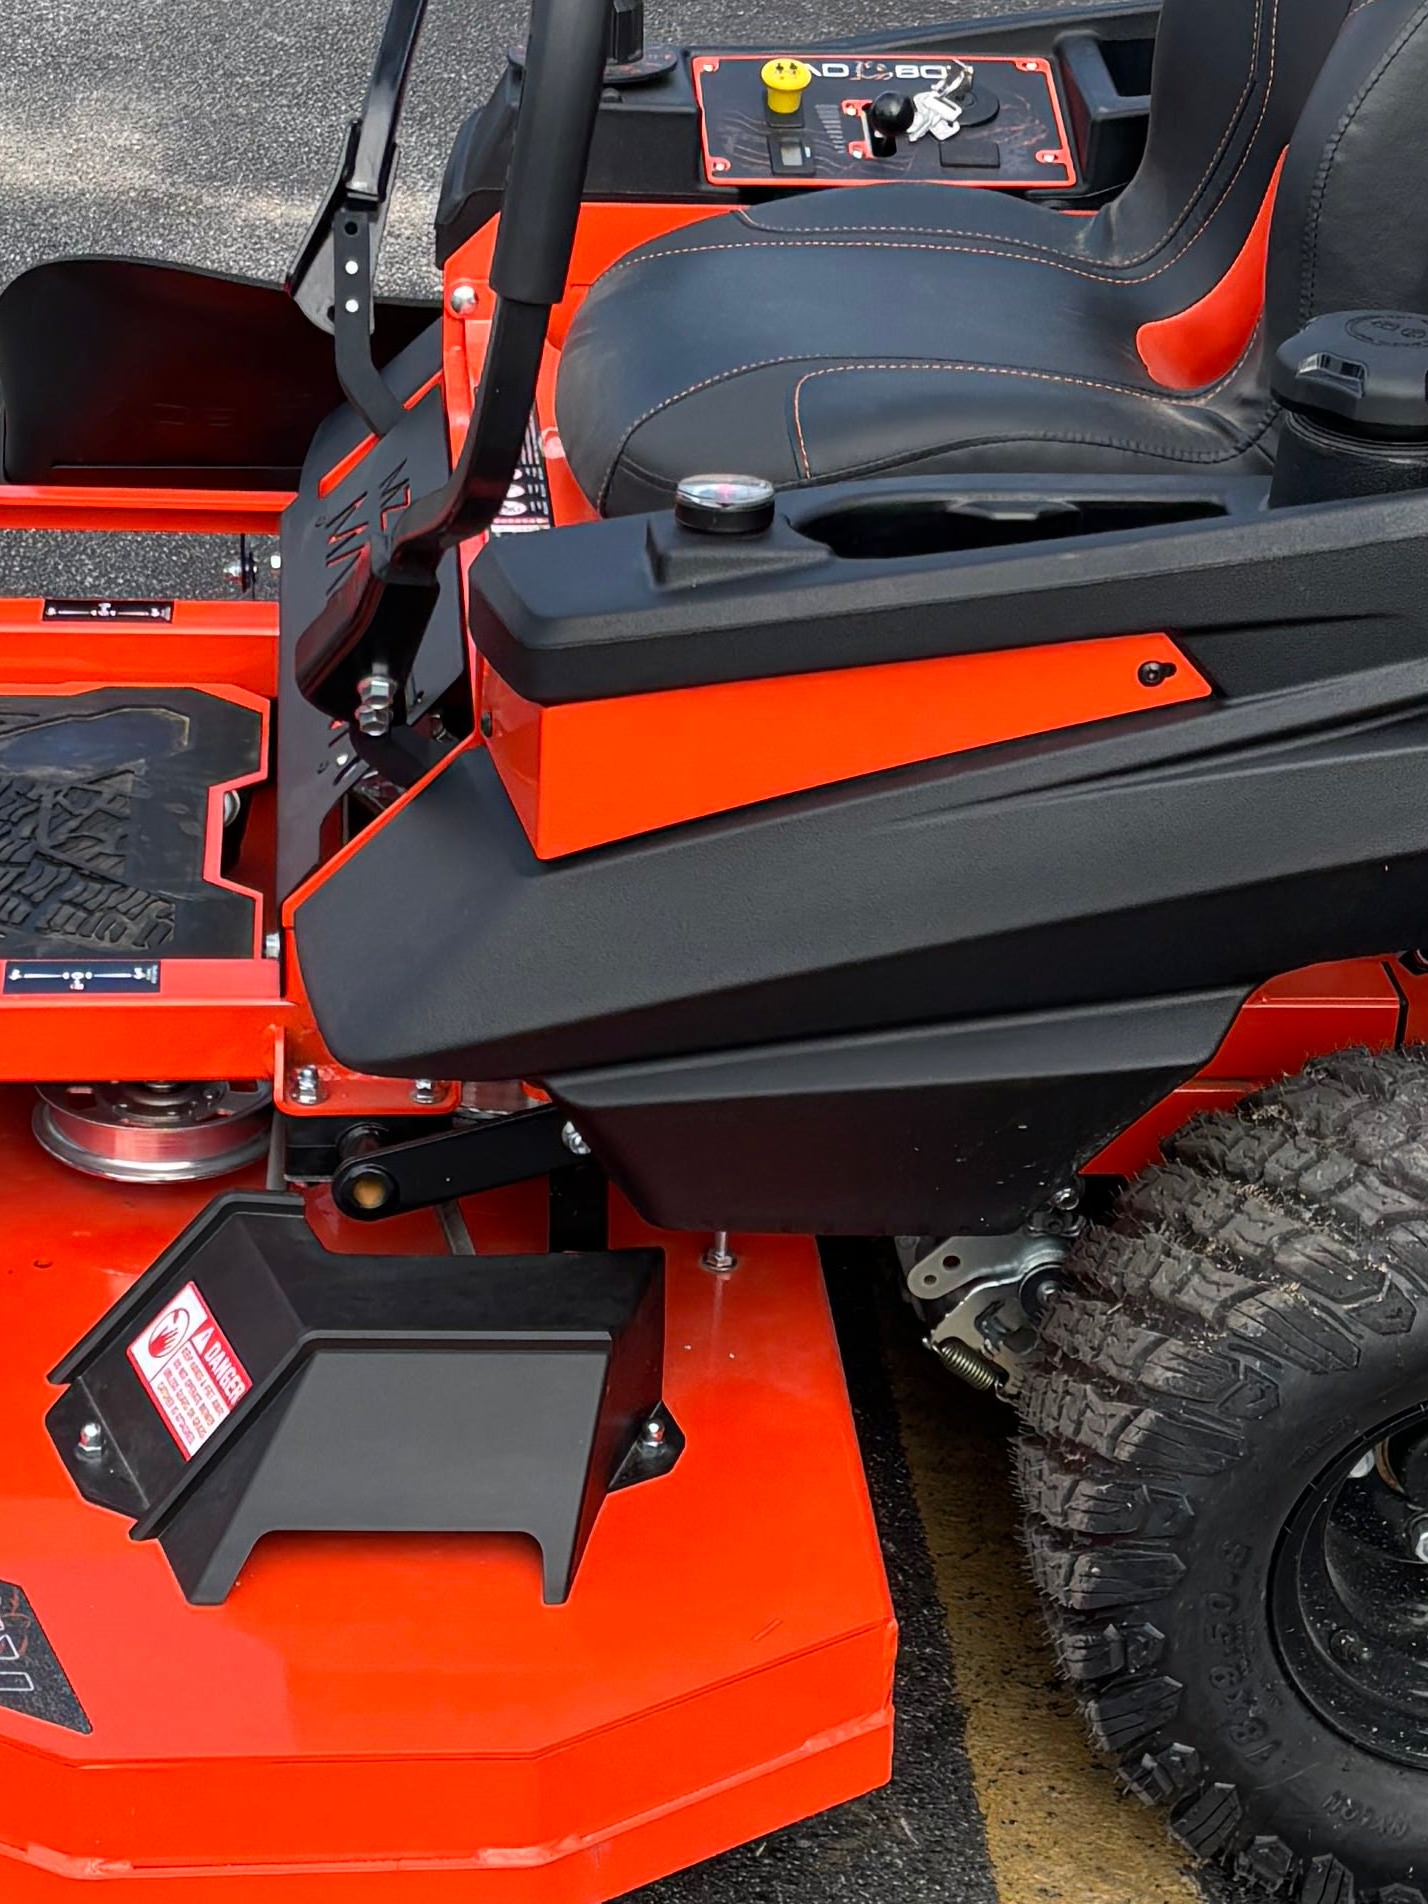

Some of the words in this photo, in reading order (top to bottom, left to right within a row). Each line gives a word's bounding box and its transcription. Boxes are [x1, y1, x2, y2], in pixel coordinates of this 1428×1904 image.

[805, 62, 850, 78] AD
[894, 63, 952, 79] BO
[203, 1340, 247, 1406] DANGER
